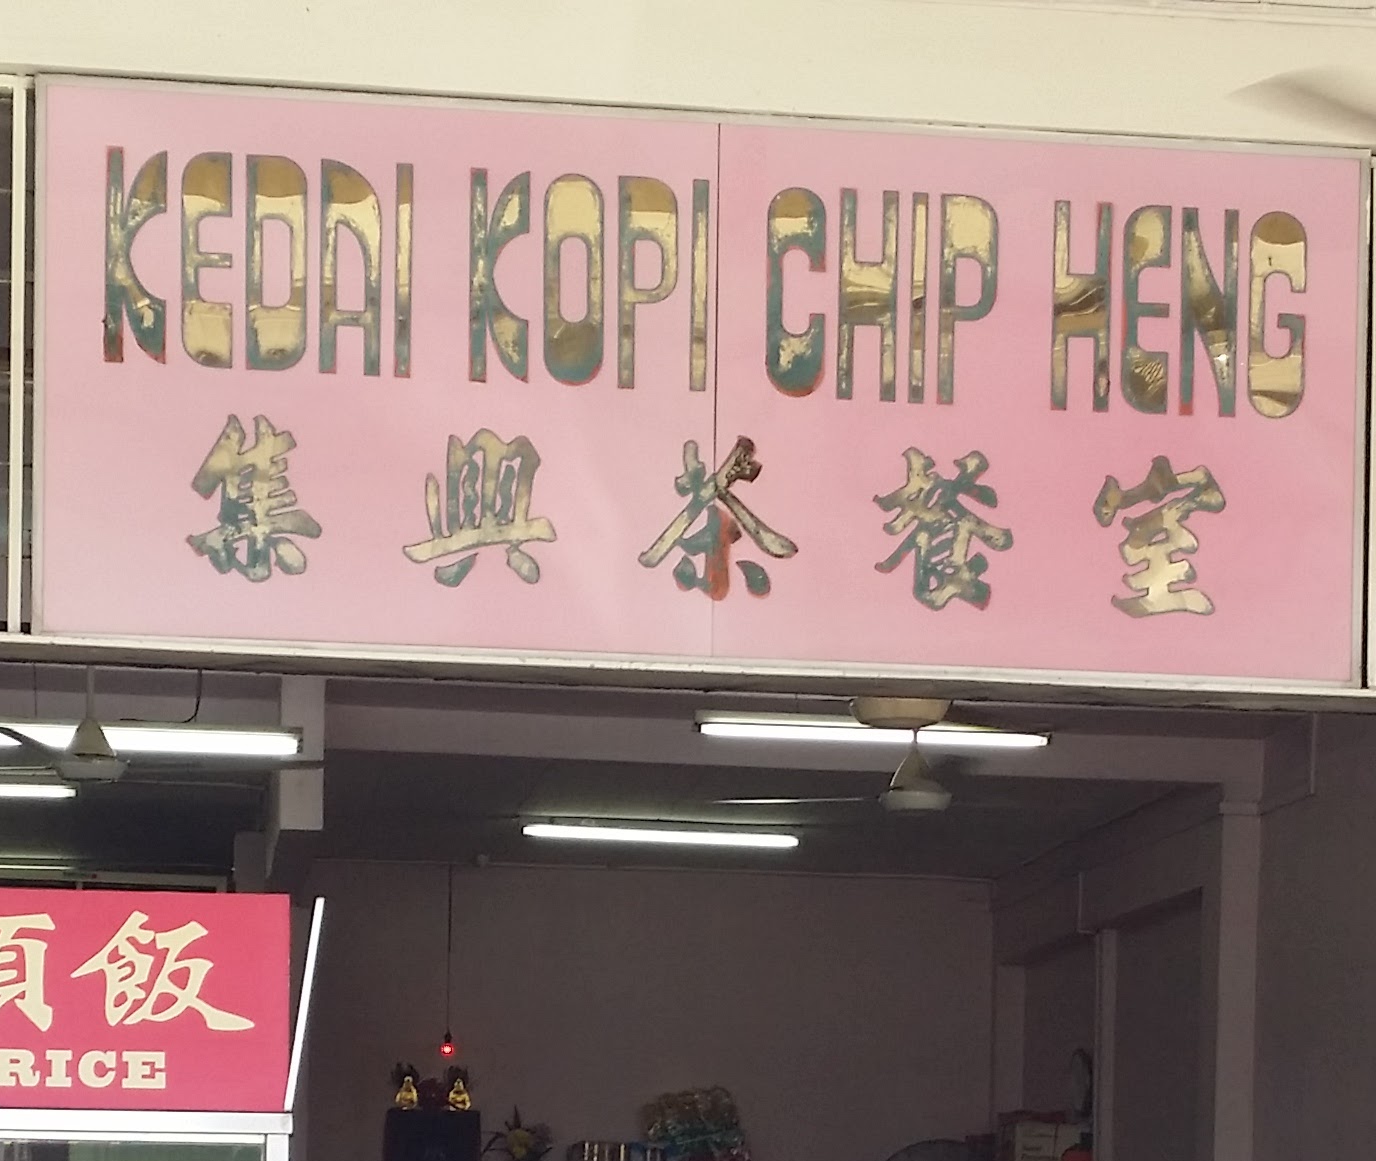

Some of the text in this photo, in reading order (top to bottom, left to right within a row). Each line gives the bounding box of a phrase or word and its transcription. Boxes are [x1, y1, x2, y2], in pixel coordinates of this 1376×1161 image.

[104, 145, 1308, 418] KEDAI KOPI CHIP HENG
[185, 413, 1228, 617] 集興茶餐室
